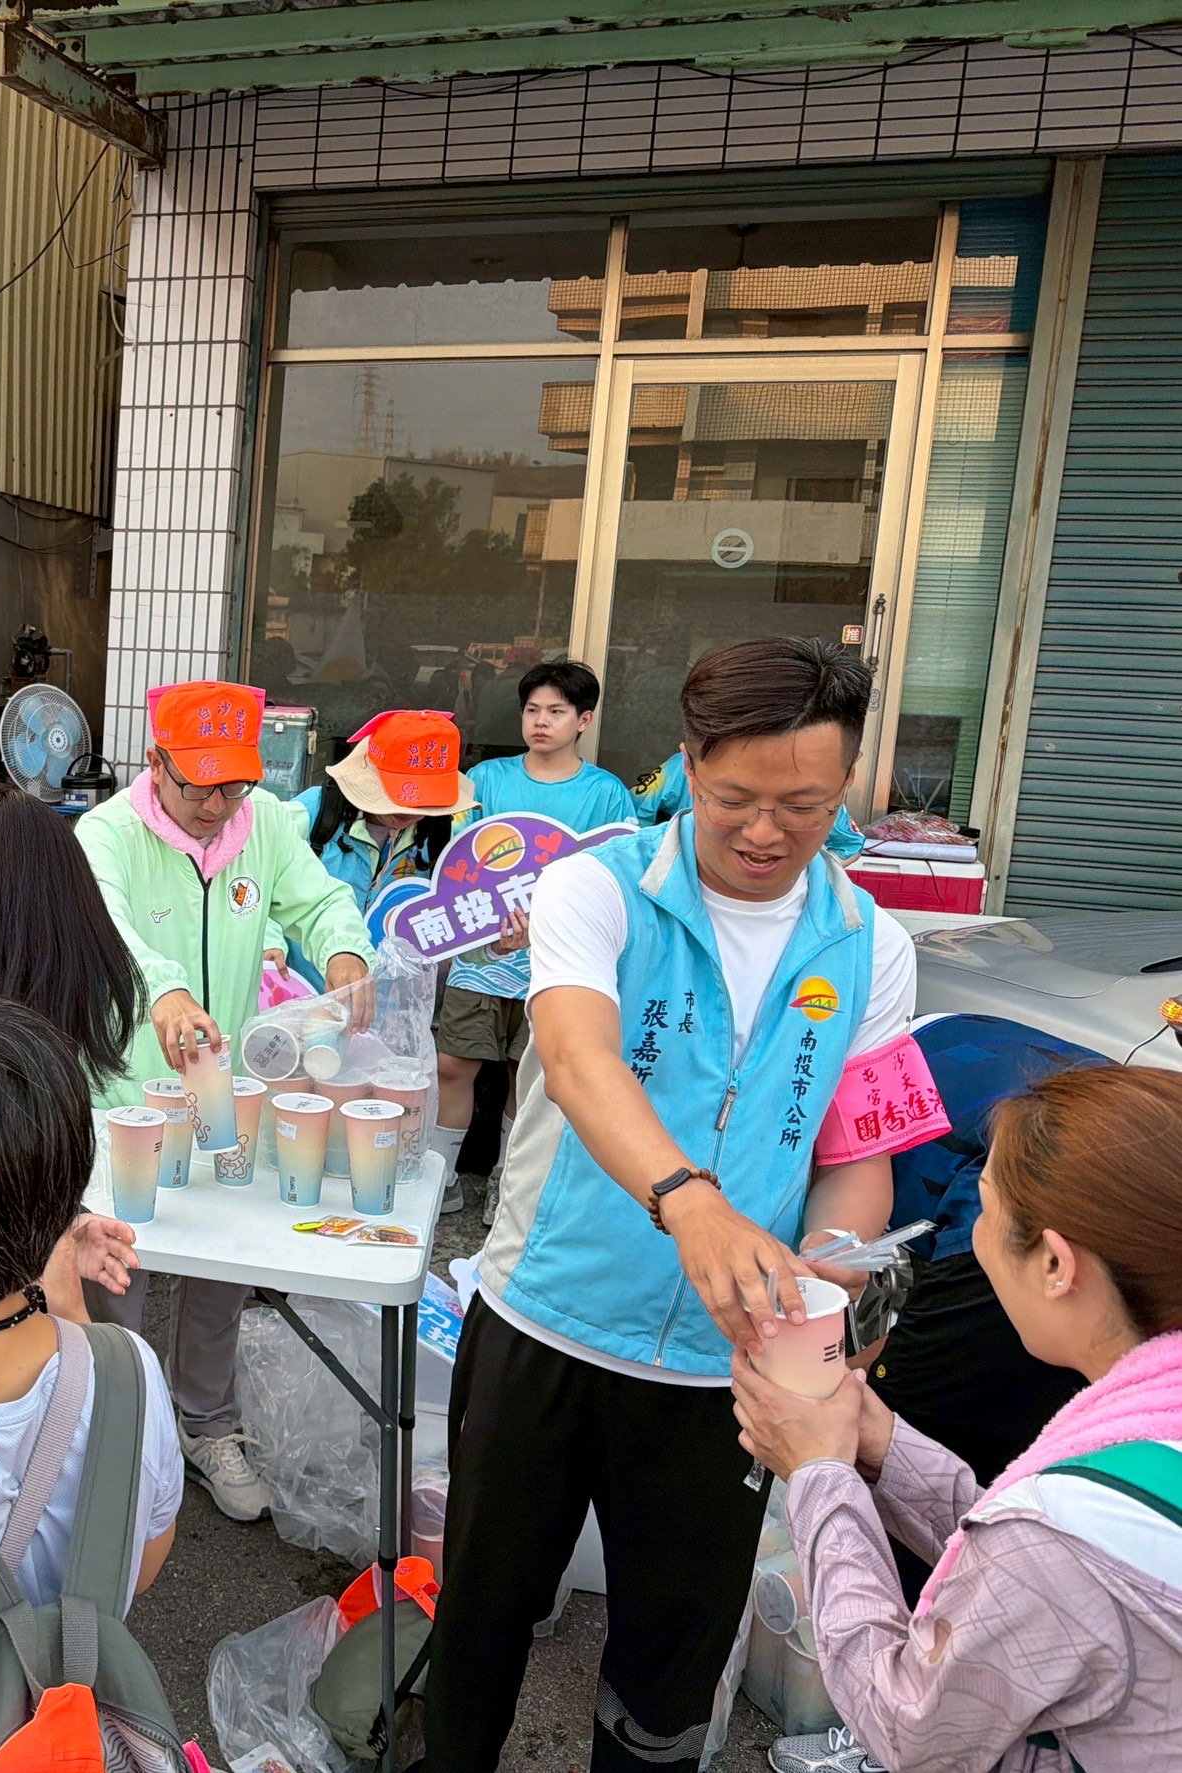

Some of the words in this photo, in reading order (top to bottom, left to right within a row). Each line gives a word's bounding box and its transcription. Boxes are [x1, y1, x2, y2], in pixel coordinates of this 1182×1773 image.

[846, 628, 860, 641] 推
[678, 988, 695, 1034] 市長
[779, 1028, 818, 1152] 南投市公所
